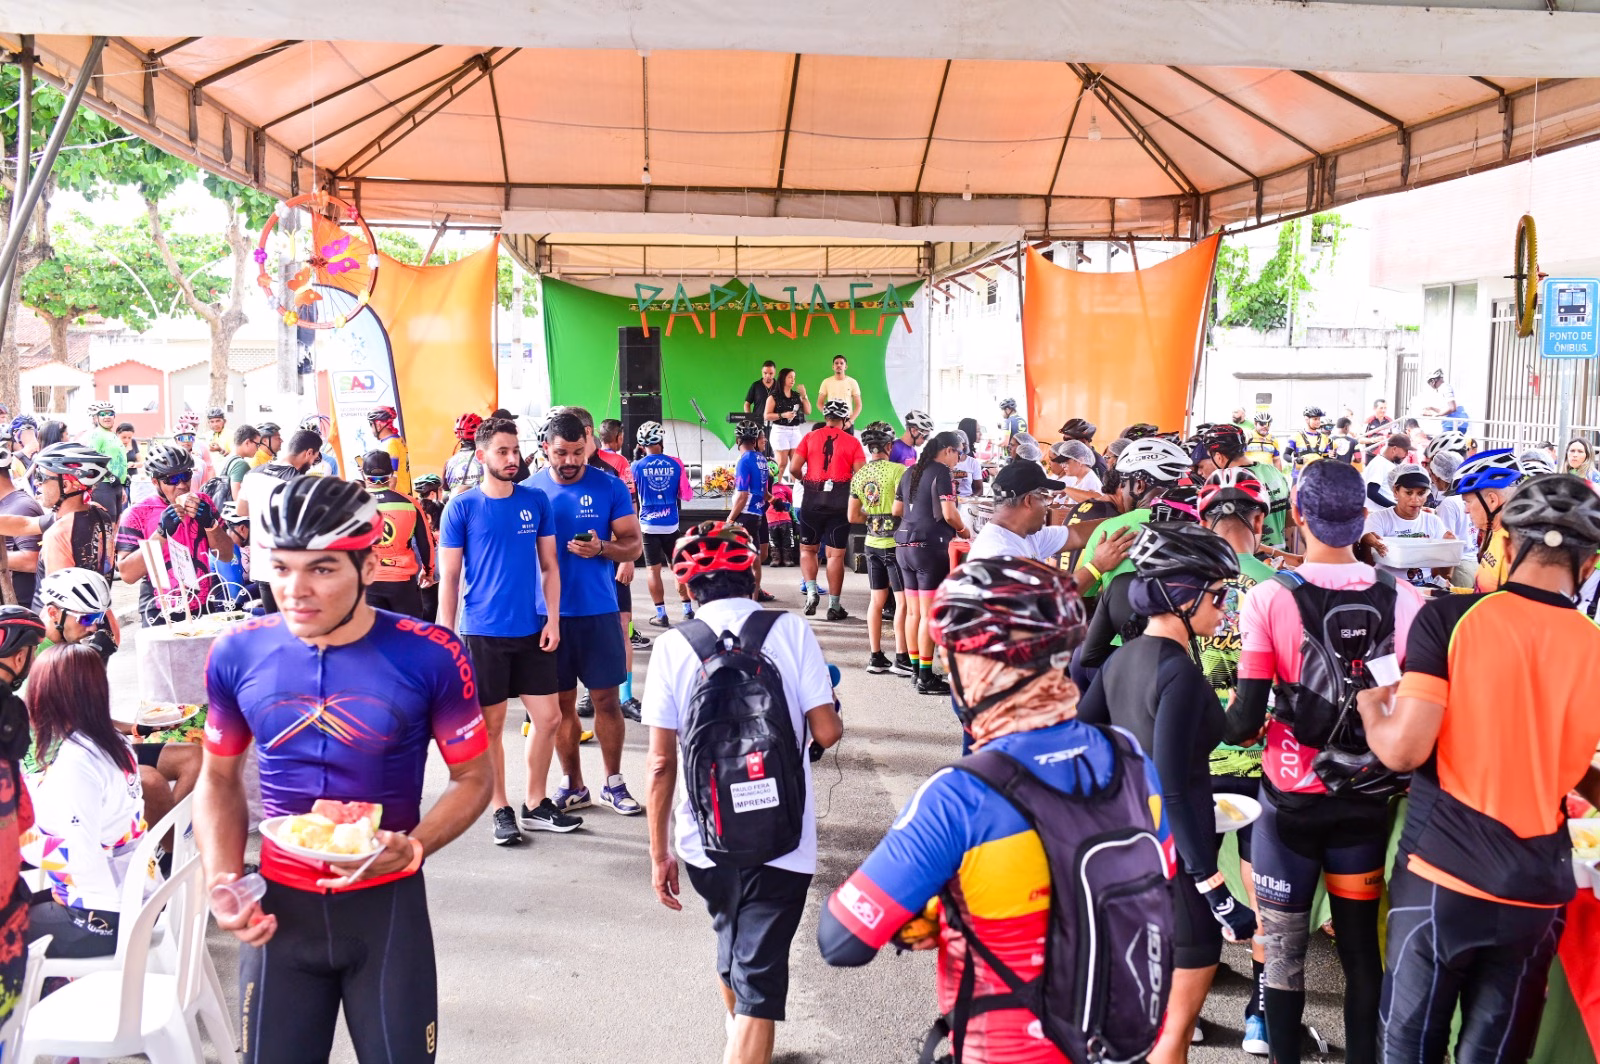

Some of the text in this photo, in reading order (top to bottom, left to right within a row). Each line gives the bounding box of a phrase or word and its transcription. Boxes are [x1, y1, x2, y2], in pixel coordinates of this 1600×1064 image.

[1549, 331, 1593, 341] PONTO DE
[340, 375, 375, 391] SAJ
[643, 467, 675, 477] BRAVUS
[46, 588, 68, 602] HJC
[396, 618, 475, 700] SUBA100
[1280, 728, 1300, 778] 202
[732, 785, 752, 793] PAULO
[733, 788, 771, 798] COMUNICAÇÃO
[735, 796, 777, 808] IMPRENSA
[1261, 874, 1291, 893] d'Italia
[1254, 885, 1290, 899] LDERLAND
